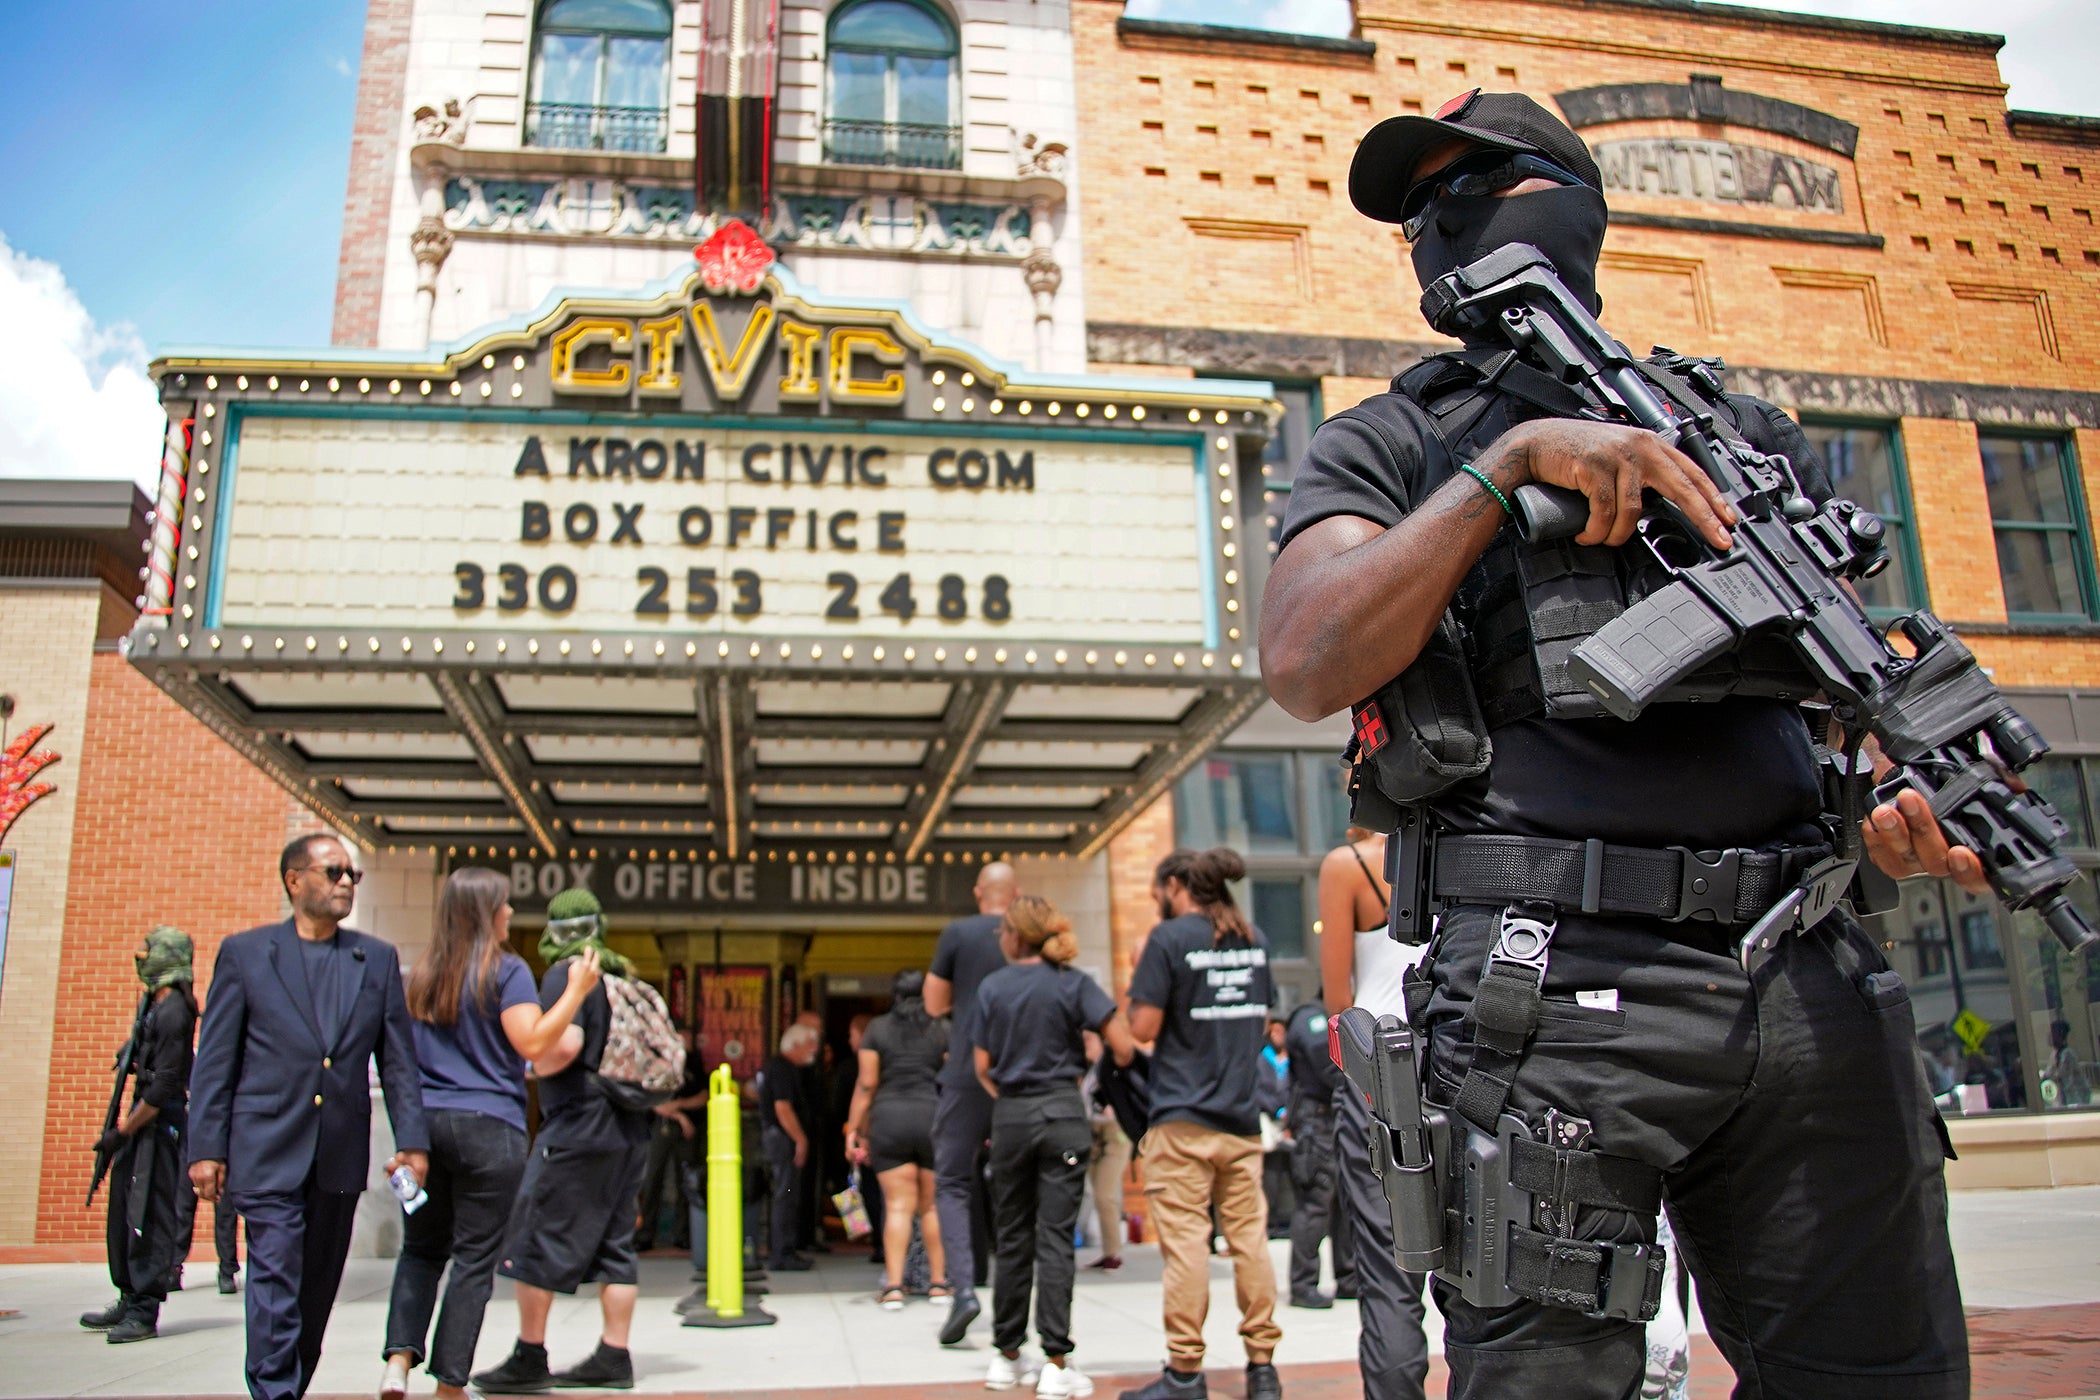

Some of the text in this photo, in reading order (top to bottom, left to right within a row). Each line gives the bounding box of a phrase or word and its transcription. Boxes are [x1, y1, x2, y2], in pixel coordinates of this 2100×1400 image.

[551, 300, 905, 405] CIVIC
[742, 442, 891, 487] CIVIC
[928, 447, 1035, 490] COM
[521, 501, 905, 551] BOX OFFICE
[453, 562, 1011, 621] 330 253 2488
[510, 862, 927, 901] BOX OFFICE INSIDE
